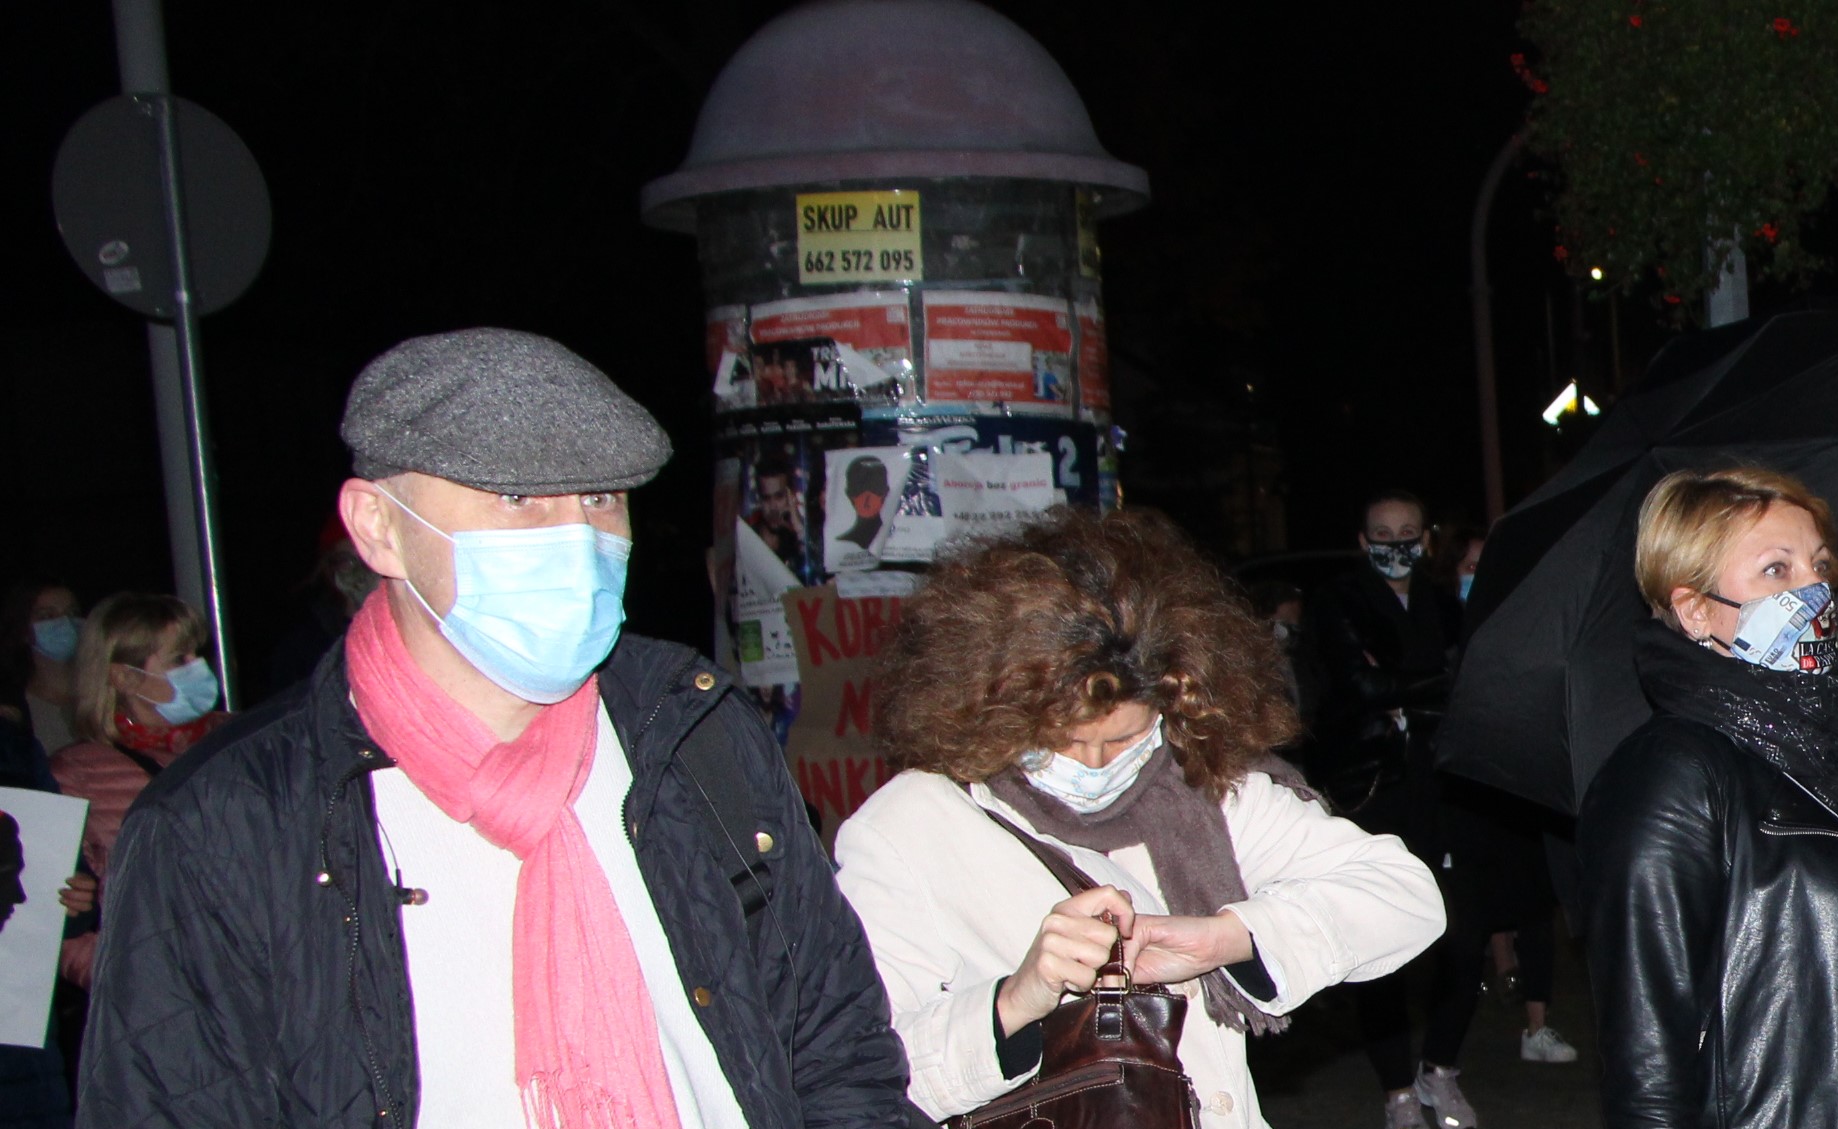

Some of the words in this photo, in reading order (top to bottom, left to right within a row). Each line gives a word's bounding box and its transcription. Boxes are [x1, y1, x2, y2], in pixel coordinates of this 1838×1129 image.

[803, 204, 858, 232] SKUP
[873, 203, 914, 231] AUT
[804, 249, 835, 273] 662
[841, 249, 874, 272] 572
[880, 249, 914, 272] 095
